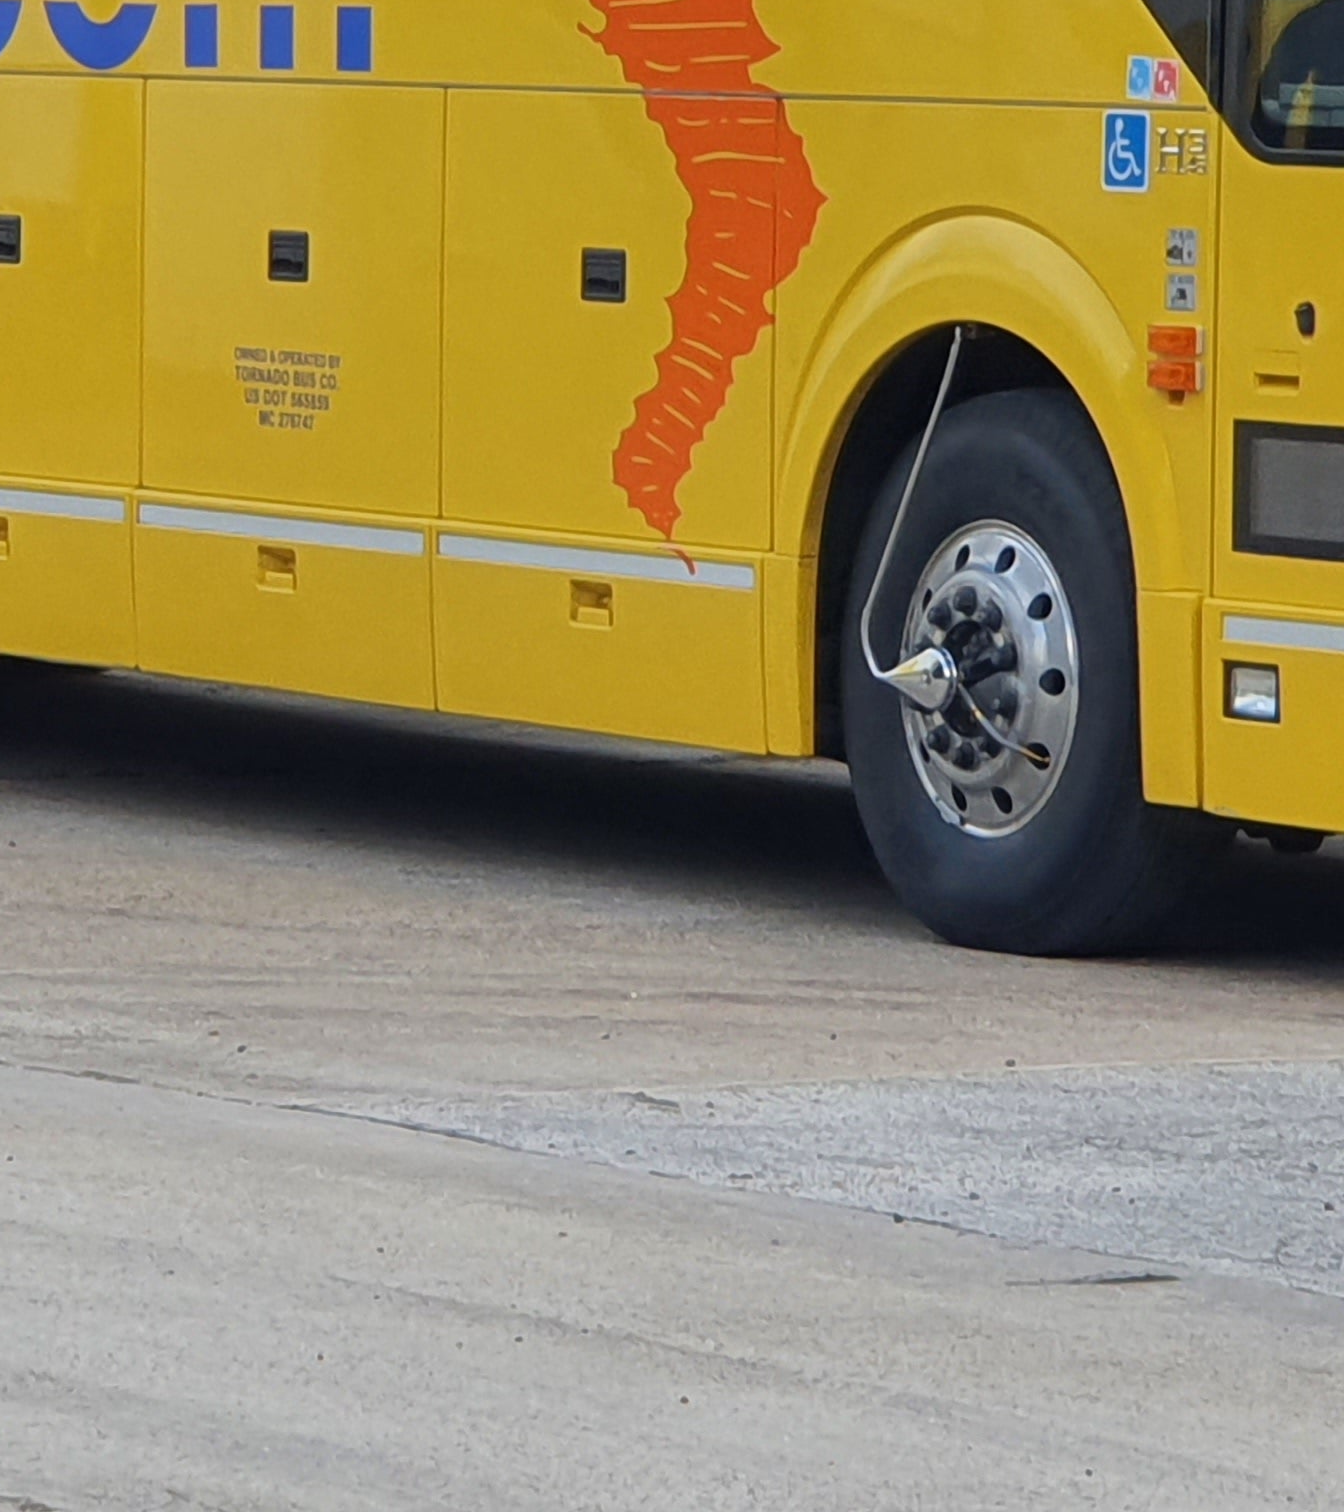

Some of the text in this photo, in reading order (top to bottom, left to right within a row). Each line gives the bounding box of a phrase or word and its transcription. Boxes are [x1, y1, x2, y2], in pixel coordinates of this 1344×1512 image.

[234, 365, 290, 386] TORNADO
[293, 370, 316, 389] BUS
[263, 389, 288, 406] DOT
